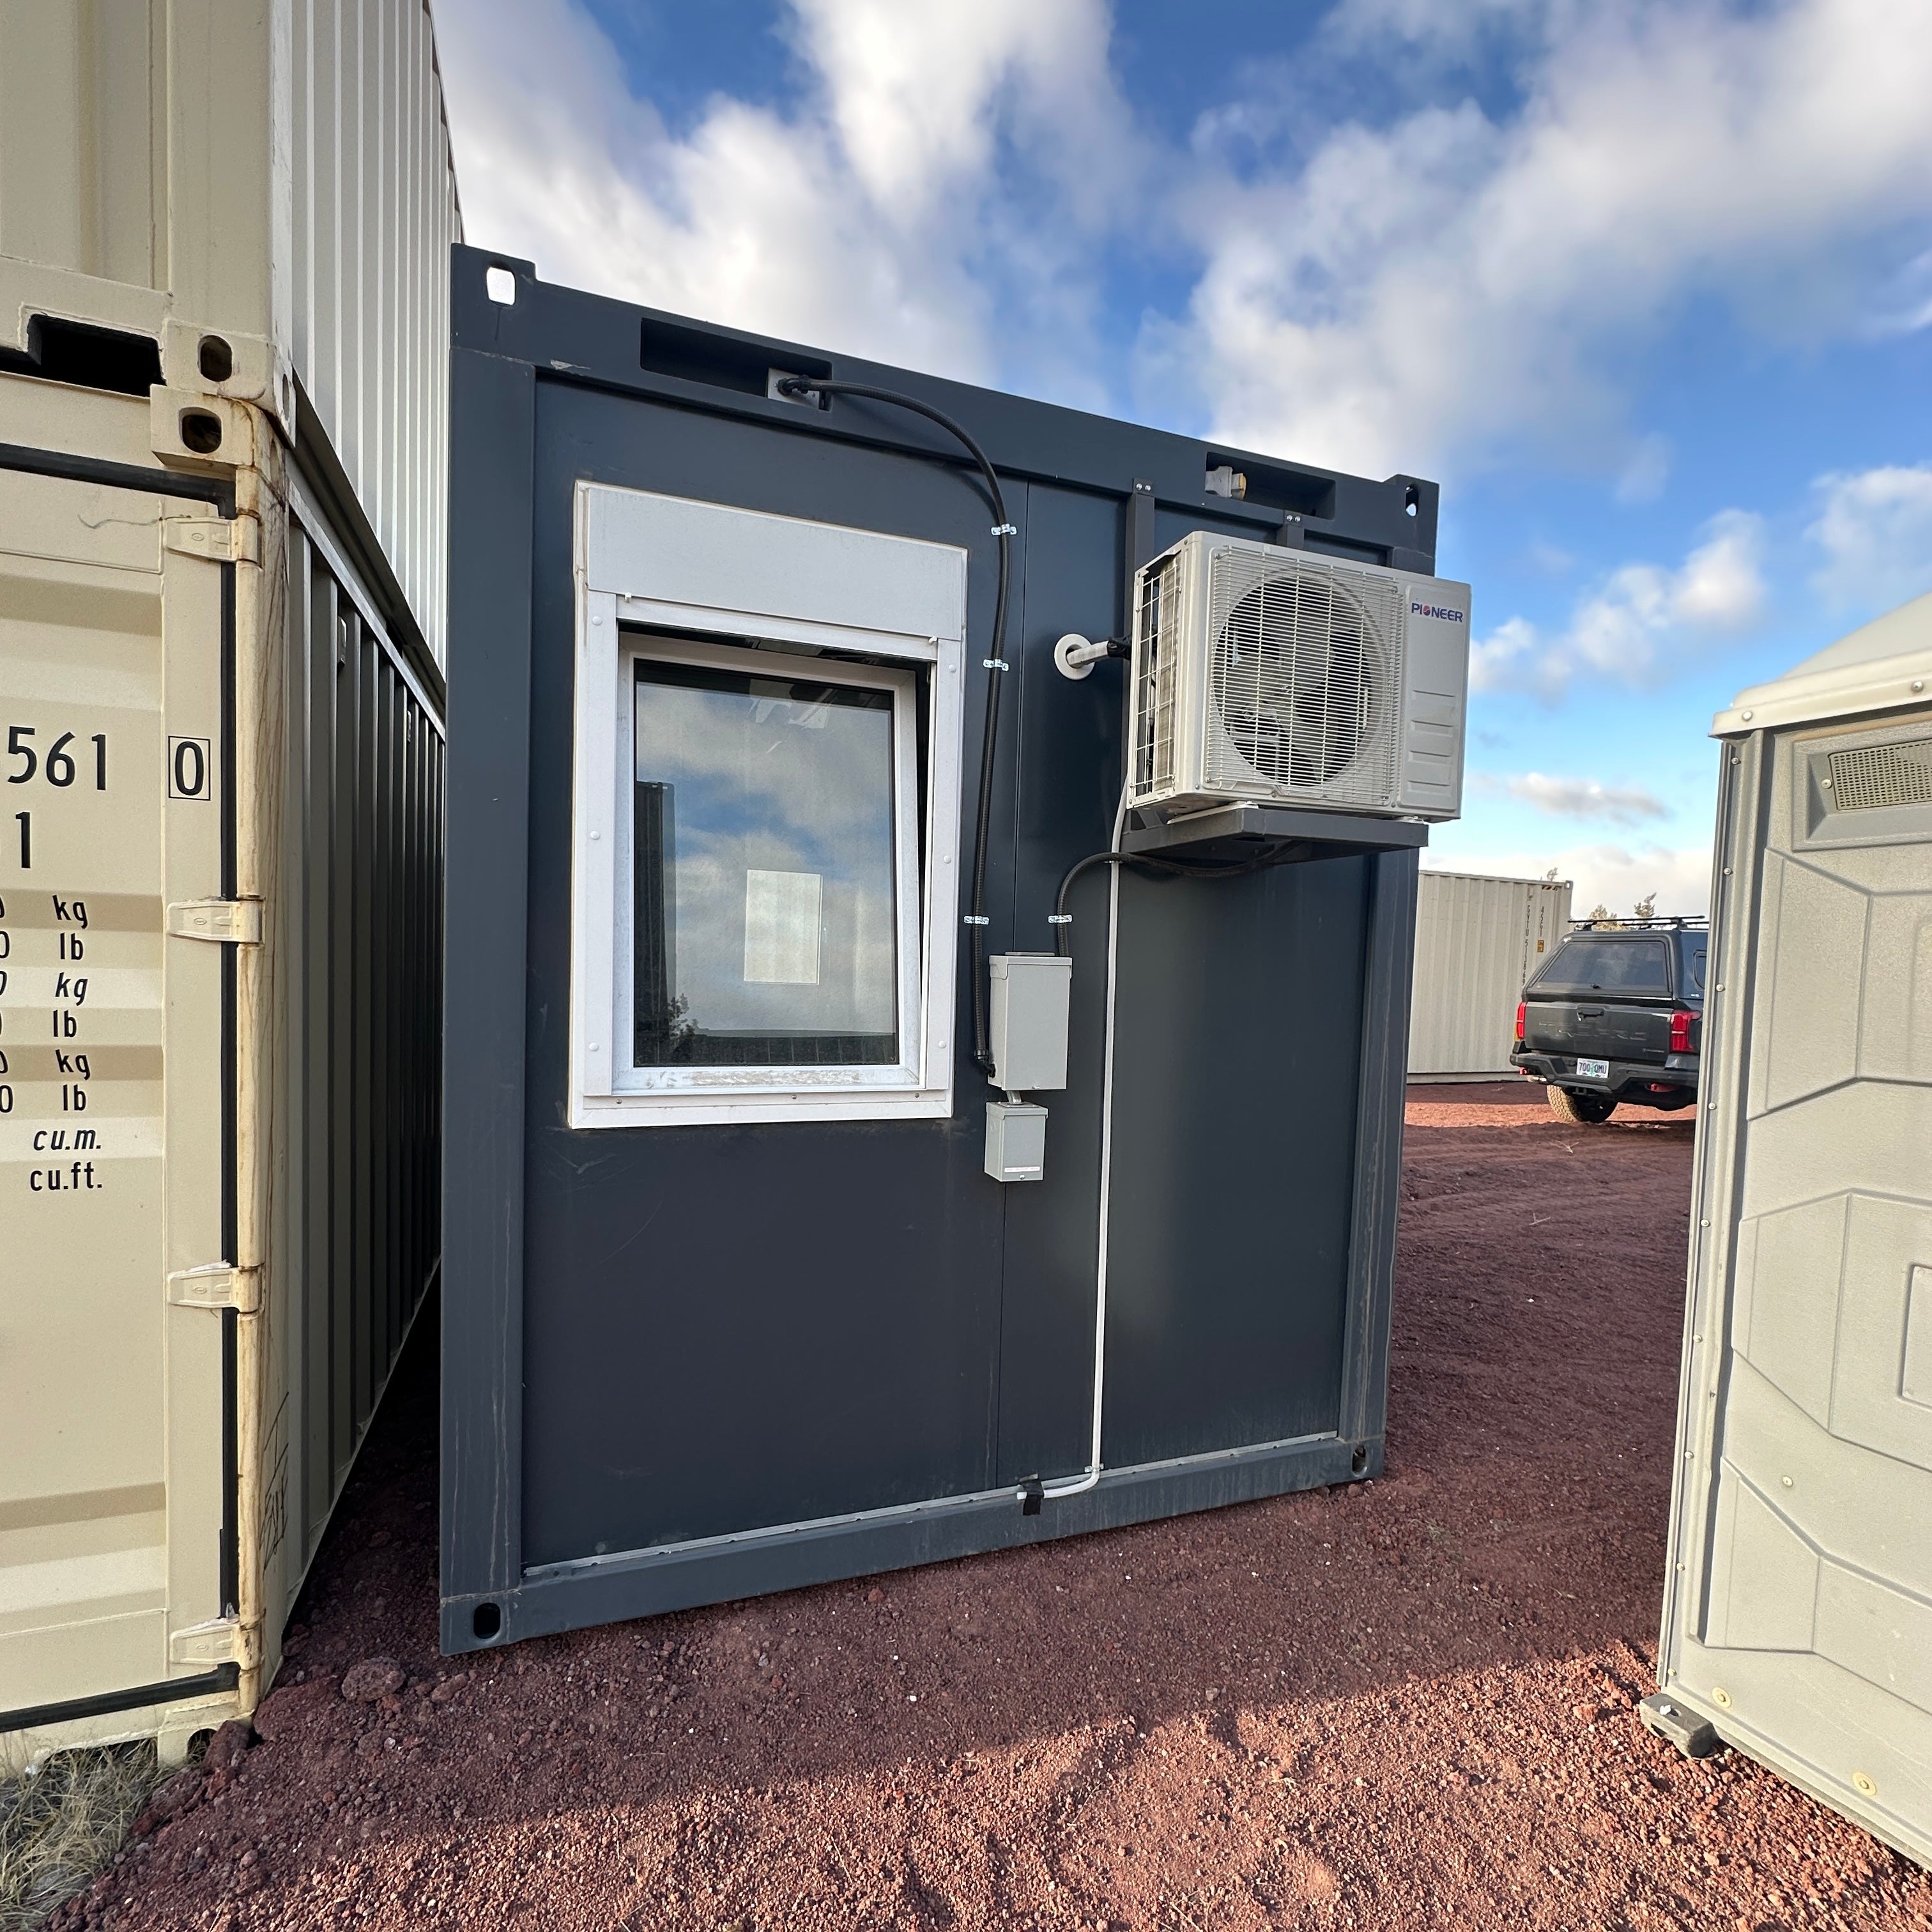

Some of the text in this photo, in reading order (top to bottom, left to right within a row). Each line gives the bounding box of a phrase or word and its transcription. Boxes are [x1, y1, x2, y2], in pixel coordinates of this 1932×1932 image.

[1411, 602, 1464, 623] PIONEER
[8, 726, 204, 795] 561 0
[52, 894, 88, 930] kg
[60, 932, 84, 960] lb
[55, 972, 88, 1006] kg
[53, 1009, 77, 1037] lb
[55, 1049, 91, 1080] kg
[63, 1084, 86, 1111] lb
[33, 1130, 102, 1151] cu.m.
[30, 1162, 102, 1192] cu.ft.
